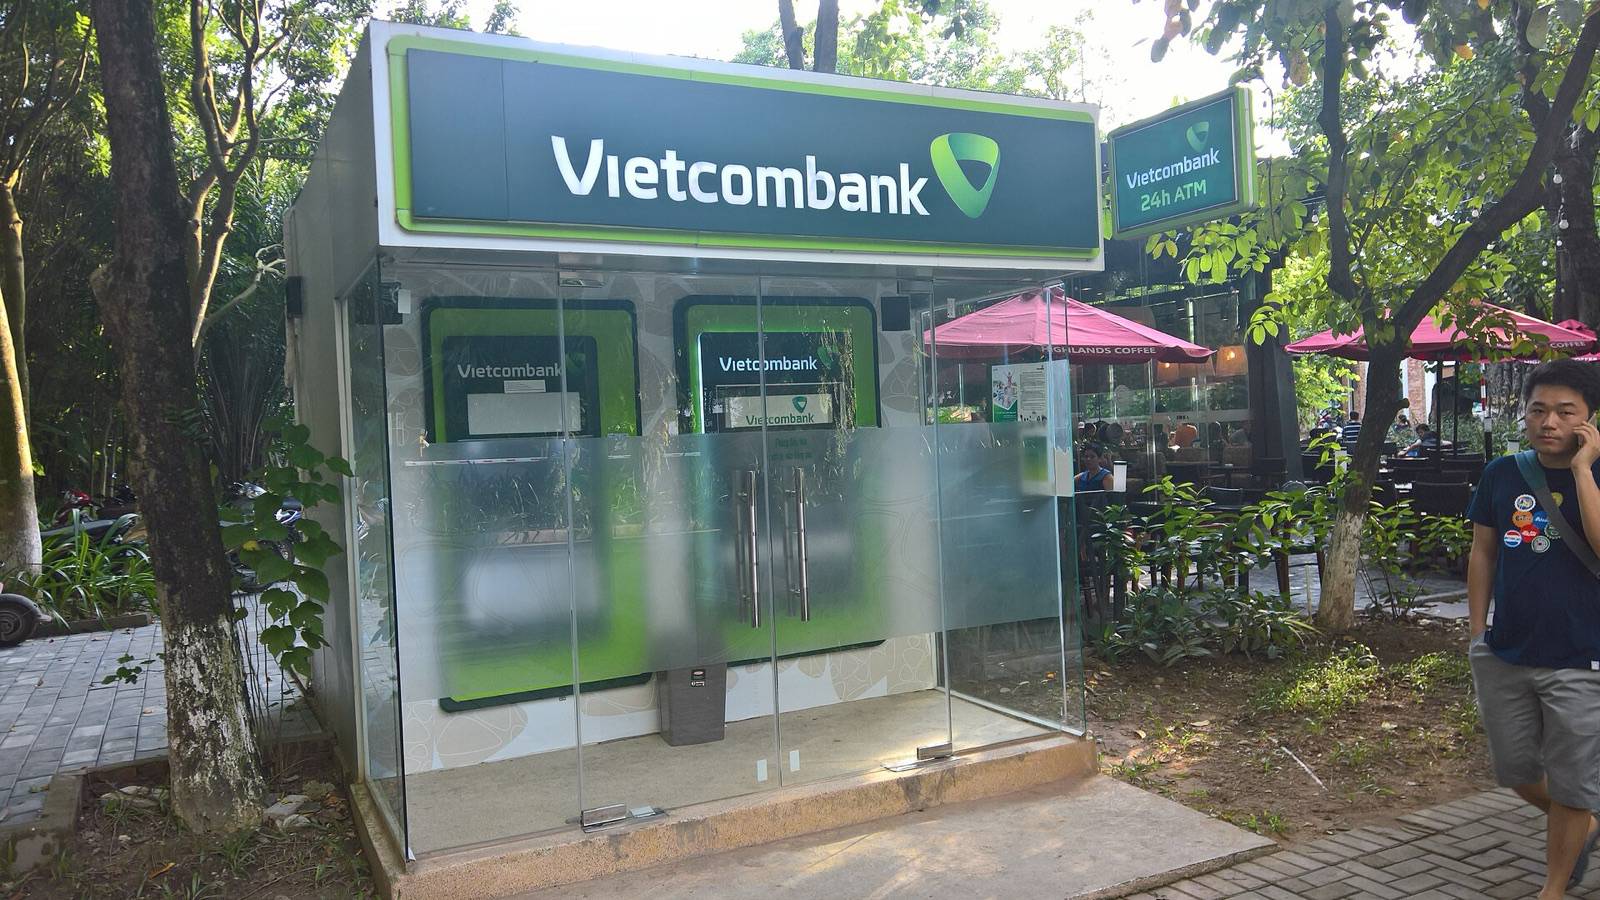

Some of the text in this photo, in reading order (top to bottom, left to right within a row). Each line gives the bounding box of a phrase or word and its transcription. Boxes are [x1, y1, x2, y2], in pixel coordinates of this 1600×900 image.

[551, 135, 931, 217] Vietcombank
[1126, 148, 1220, 189] Vietcombank
[1141, 179, 1207, 212] 24h ATM
[457, 363, 562, 378] Vietcombank
[720, 356, 818, 371] Vietcombank
